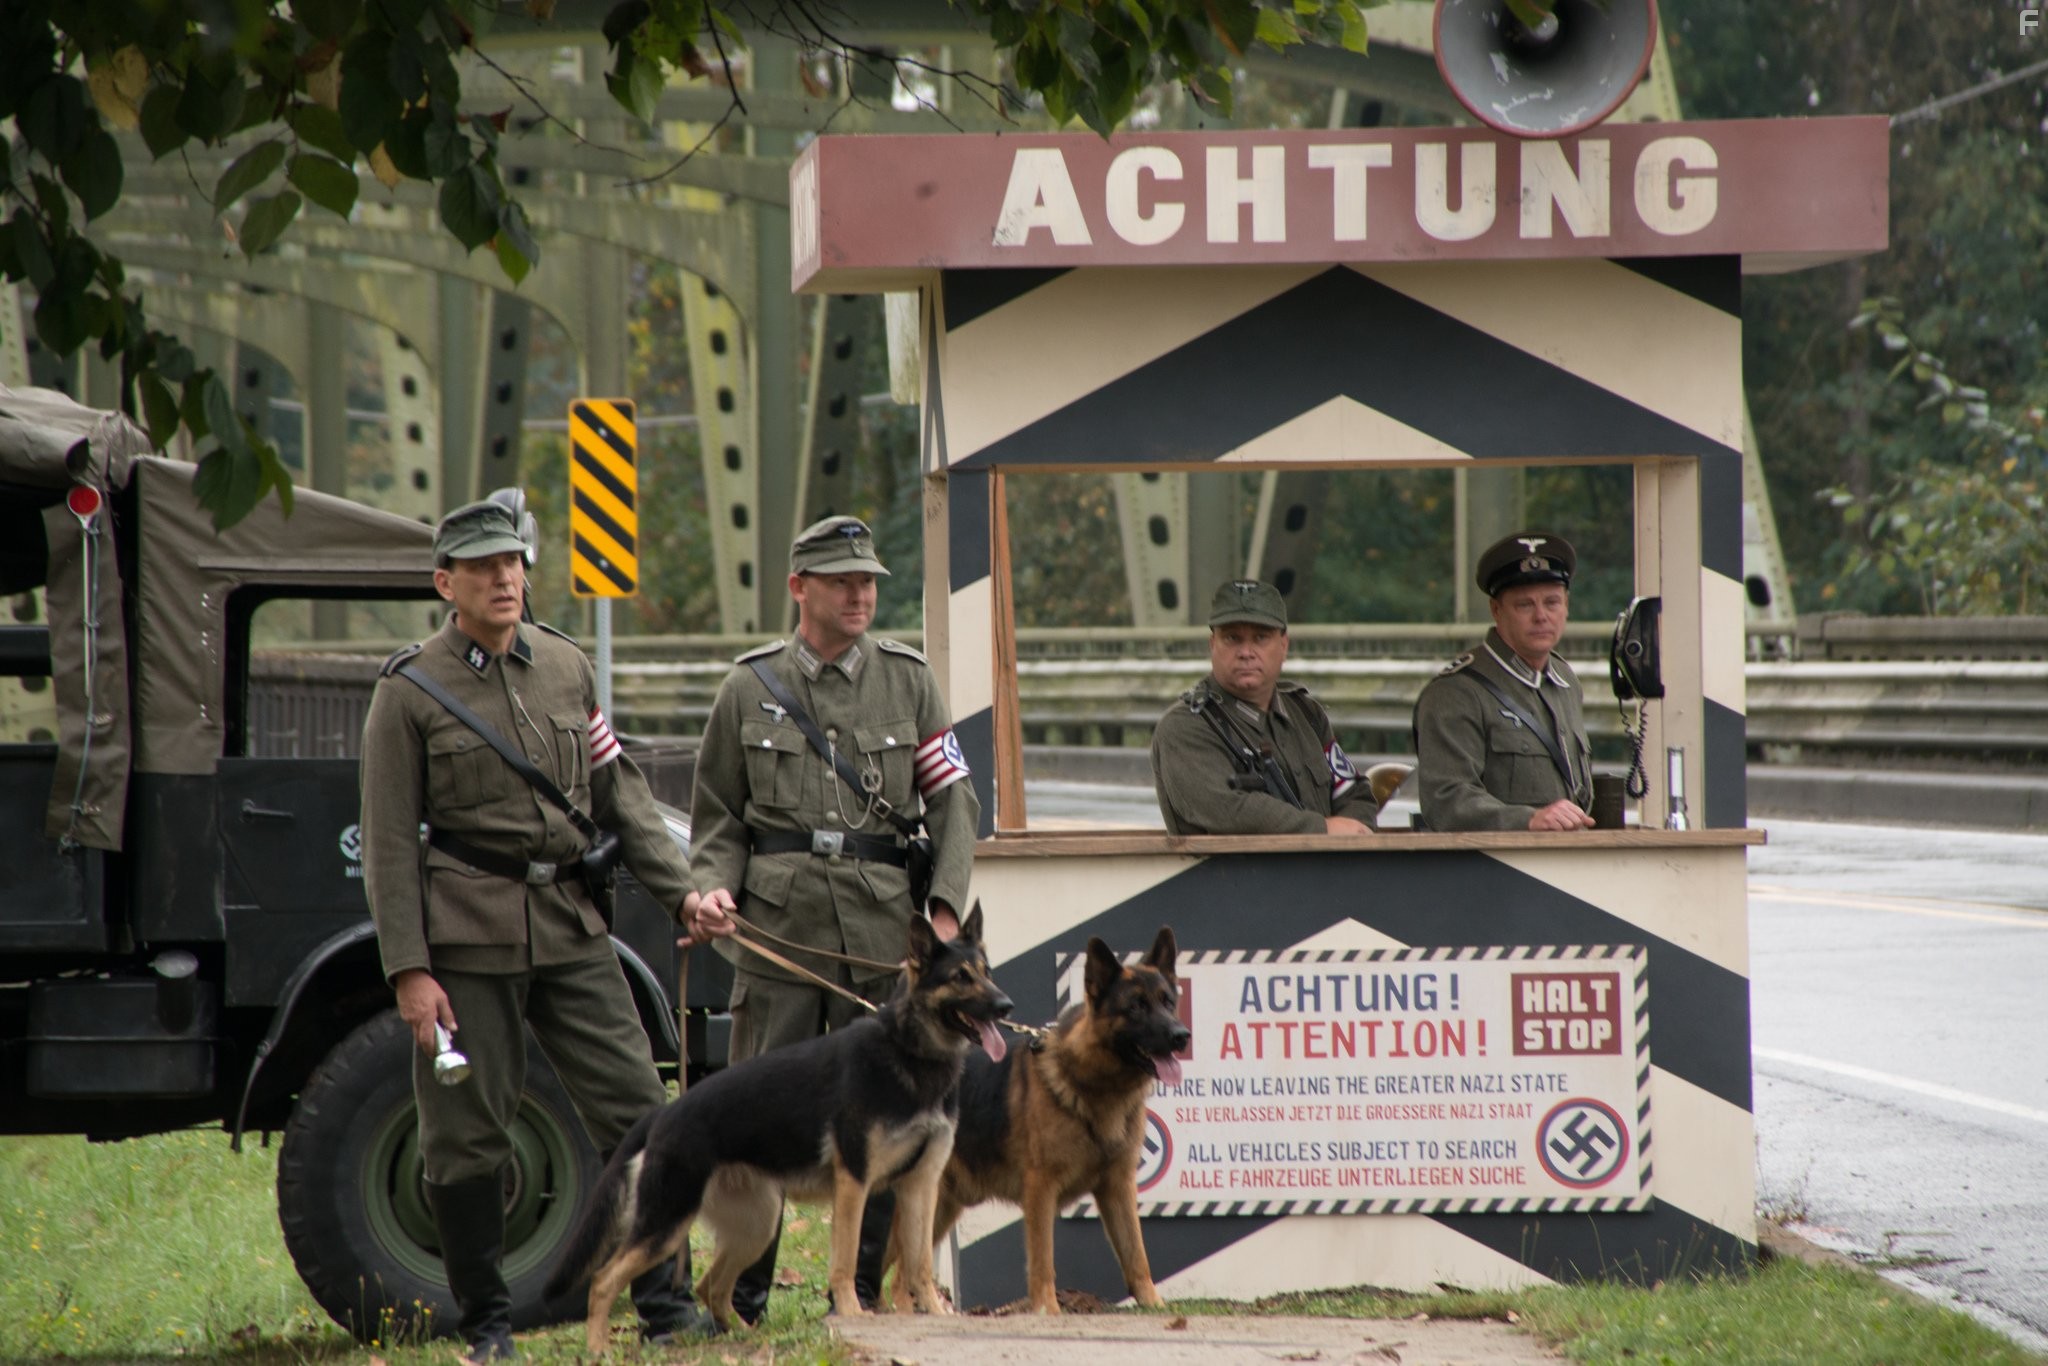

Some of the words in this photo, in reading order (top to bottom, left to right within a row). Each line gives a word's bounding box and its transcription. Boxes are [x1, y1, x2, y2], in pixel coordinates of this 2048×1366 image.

[992, 136, 1718, 246] ACHTUNG
[1239, 973, 1459, 1013] ACHTUNG!
[1522, 979, 1612, 1013] HALT
[1220, 1019, 1487, 1060] ATTENTION!
[1523, 1018, 1612, 1050] STOP
[1173, 1078, 1206, 1097] ARE
[1211, 1077, 1245, 1097] NOW
[1251, 1075, 1330, 1097] LEAVING
[1336, 1075, 1370, 1096] THE
[1375, 1074, 1455, 1095] GREATER
[1461, 1074, 1505, 1094] NAZI
[1511, 1073, 1568, 1094] STATE
[1175, 1107, 1200, 1123] SIE
[1205, 1105, 1285, 1122] VERLASSEN
[1289, 1104, 1332, 1122] JETZT
[1337, 1104, 1362, 1121] DIE
[1366, 1103, 1446, 1121] GROESSERE
[1450, 1103, 1484, 1120] NAZI
[1489, 1102, 1533, 1119] STAAT
[1188, 1143, 1222, 1163] ALL
[1228, 1142, 1321, 1163] VEHICLES
[1327, 1140, 1410, 1162] SUBJECT
[1416, 1140, 1439, 1160] TO
[1445, 1139, 1517, 1160] SEARCH
[1179, 1170, 1224, 1189] ALLE
[1230, 1168, 1333, 1188] FAHRZEUGE
[1338, 1167, 1464, 1188] UNTERLIEGEN
[1469, 1166, 1526, 1185] SUCHE
